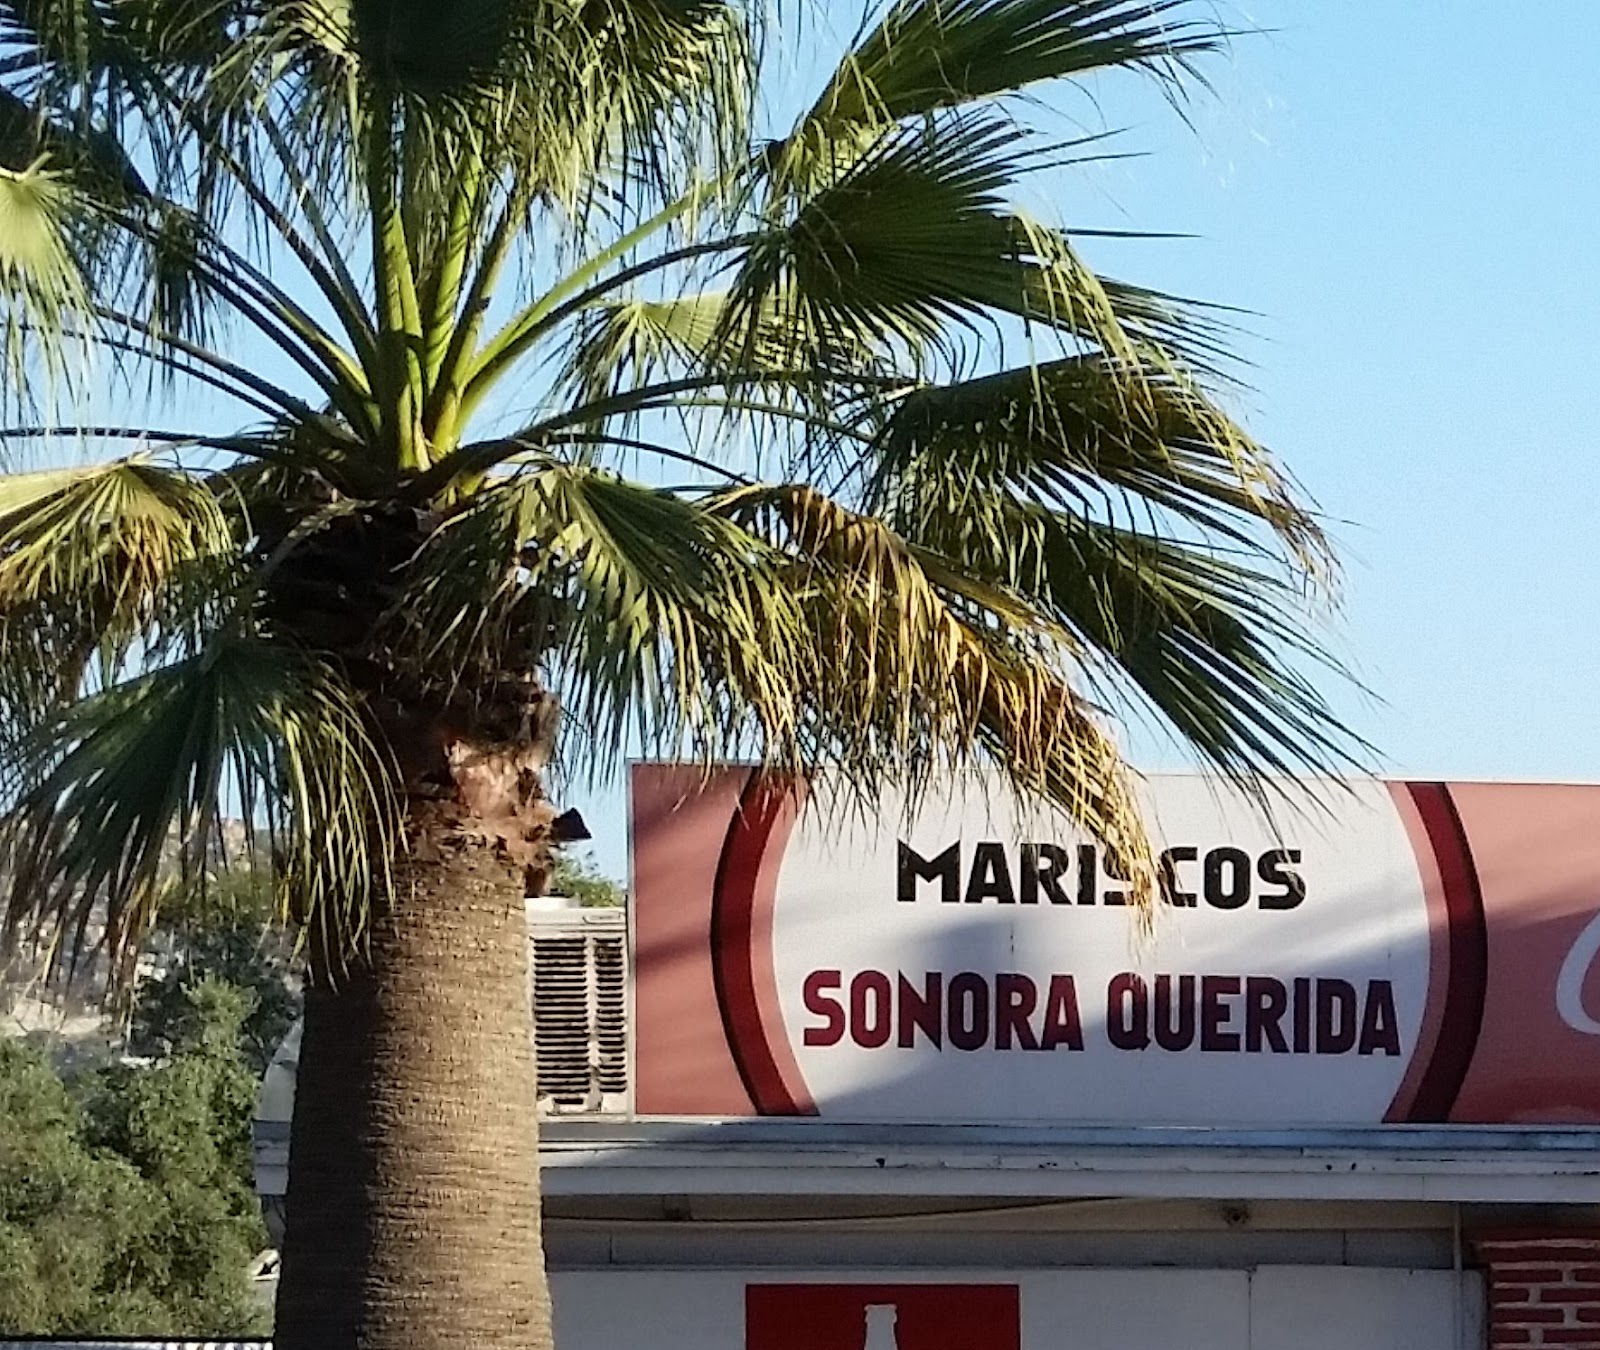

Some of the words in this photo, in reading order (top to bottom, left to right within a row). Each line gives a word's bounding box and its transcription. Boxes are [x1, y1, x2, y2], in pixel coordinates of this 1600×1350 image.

[897, 840, 1306, 911] MARISCOS
[802, 969, 1085, 1052] SONORA
[1107, 972, 1401, 1056] QUERIDA
